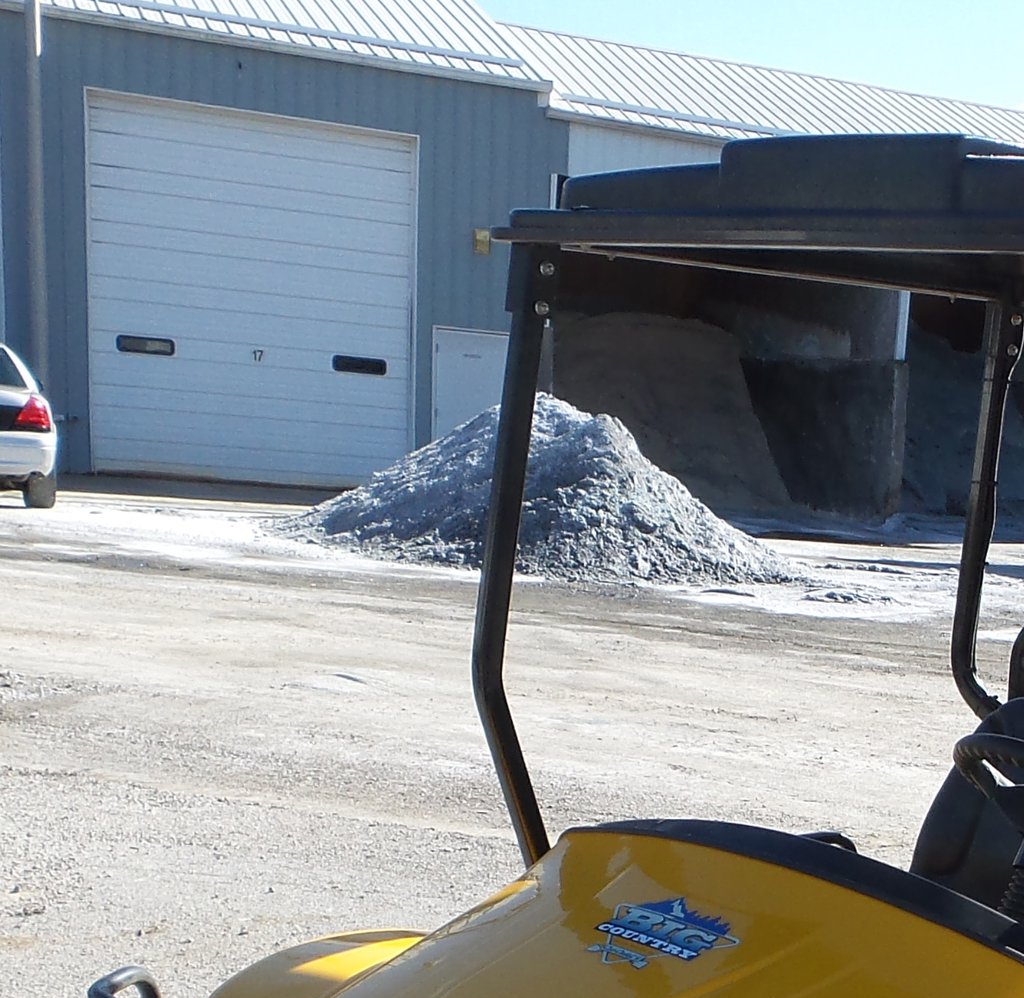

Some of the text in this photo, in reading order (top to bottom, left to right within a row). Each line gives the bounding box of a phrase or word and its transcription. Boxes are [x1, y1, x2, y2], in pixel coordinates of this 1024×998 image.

[252, 350, 264, 362] 17
[598, 923, 700, 959] COUNTRY
[612, 907, 719, 951] BIG
